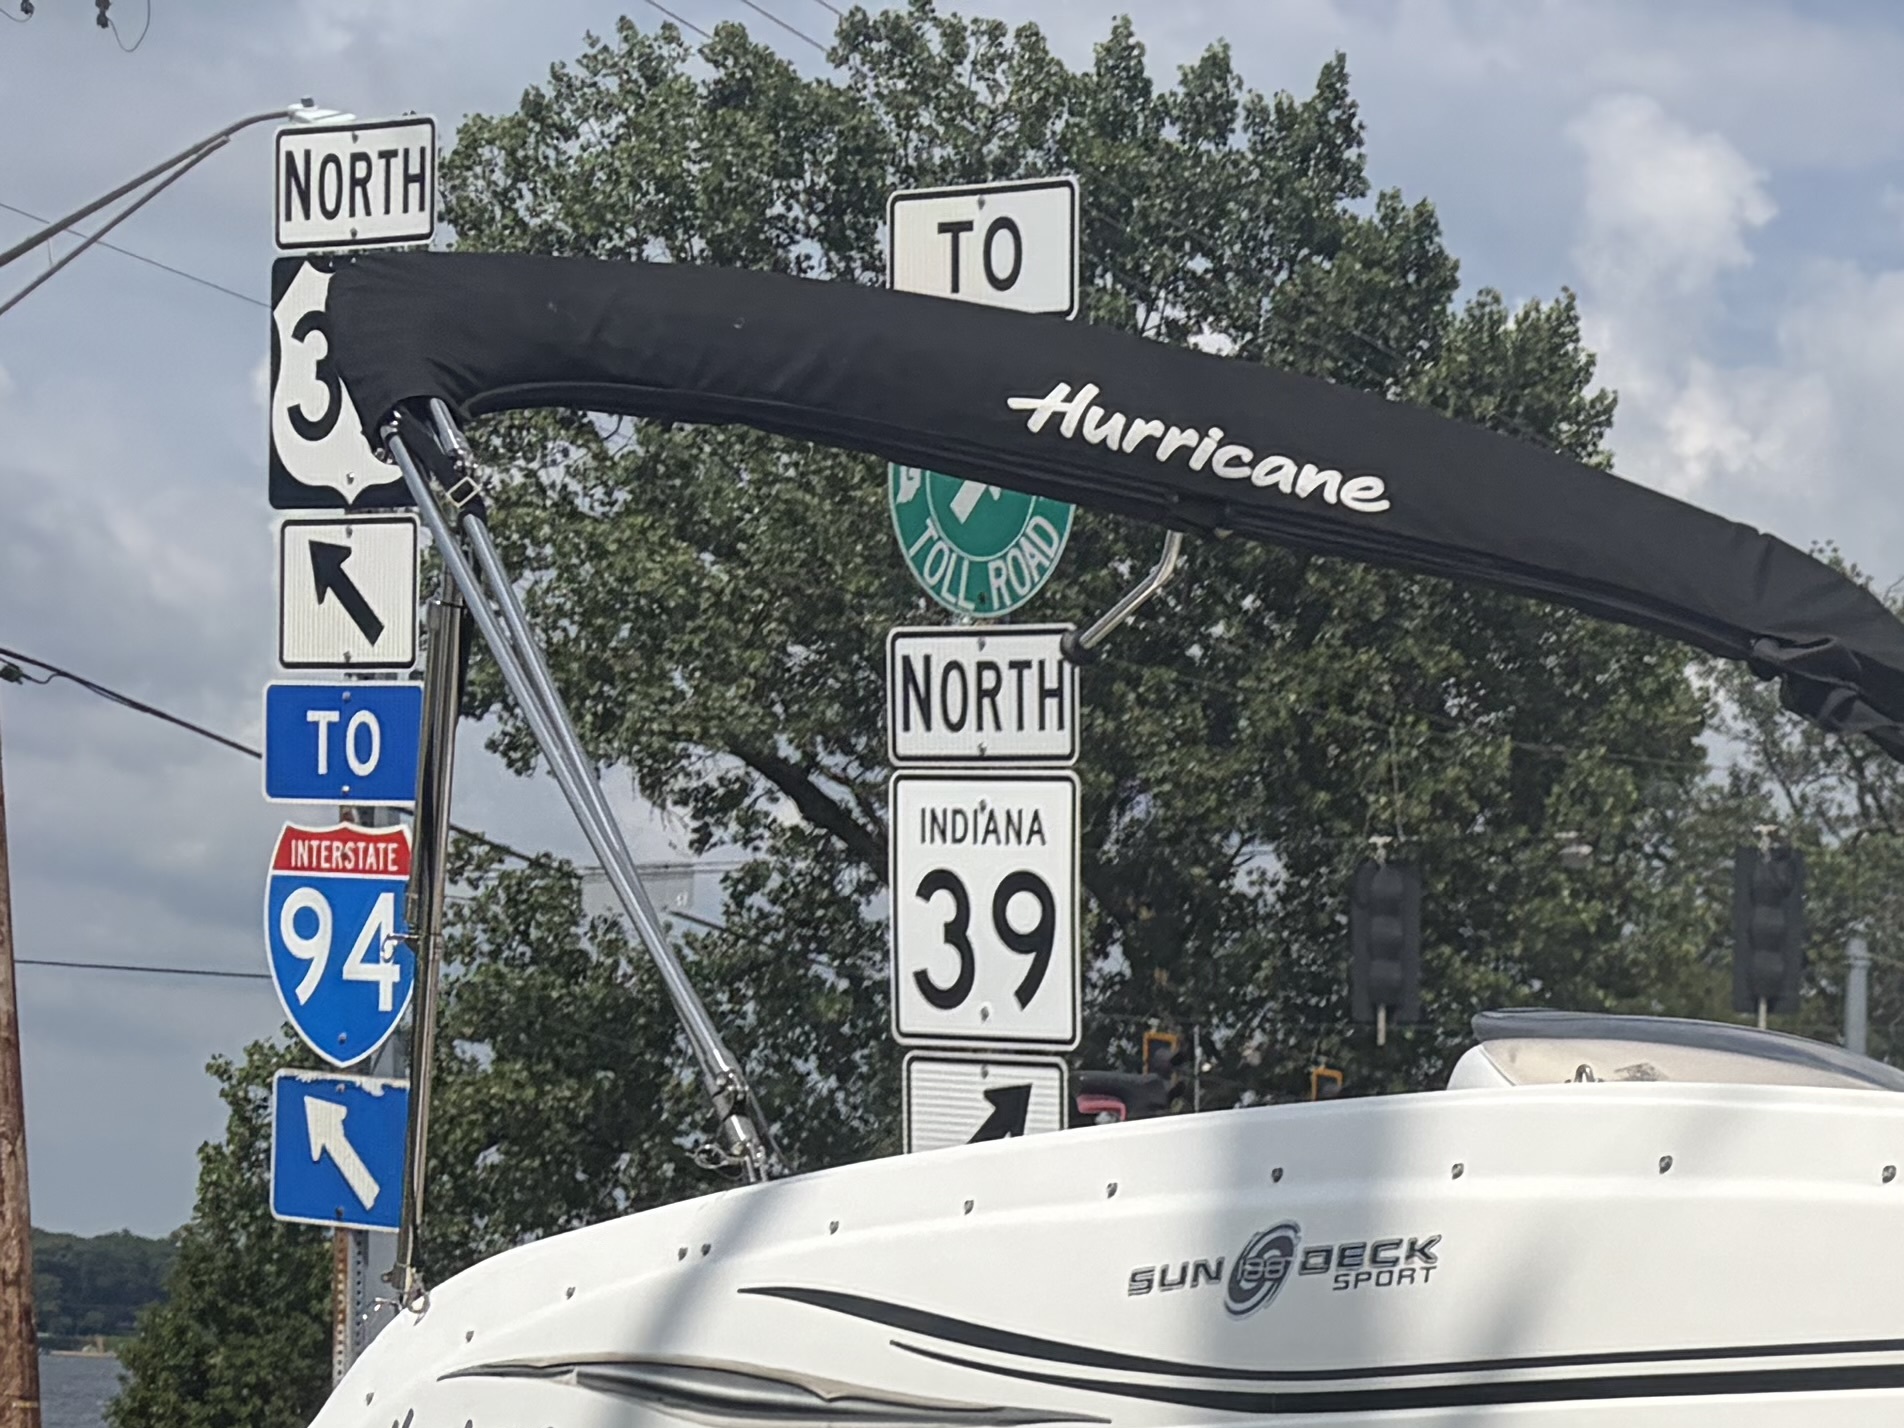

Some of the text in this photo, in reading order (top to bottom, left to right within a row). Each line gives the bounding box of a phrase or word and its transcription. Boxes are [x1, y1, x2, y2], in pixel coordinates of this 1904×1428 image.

[284, 146, 427, 223] NORTH
[937, 216, 1023, 294] TO
[1006, 382, 1391, 513] Hurricane
[908, 515, 1061, 610] TOLL ROAD
[902, 654, 1066, 733] NORTH
[306, 709, 381, 777] TO
[291, 838, 399, 872] INTERSTATE
[920, 806, 1047, 846] INDIANA
[280, 887, 401, 1013] 94
[912, 868, 1057, 1012] 39
[1127, 1256, 1226, 1297] SUN
[1298, 1234, 1443, 1277] DECK
[1332, 1265, 1438, 1291] SPORT
